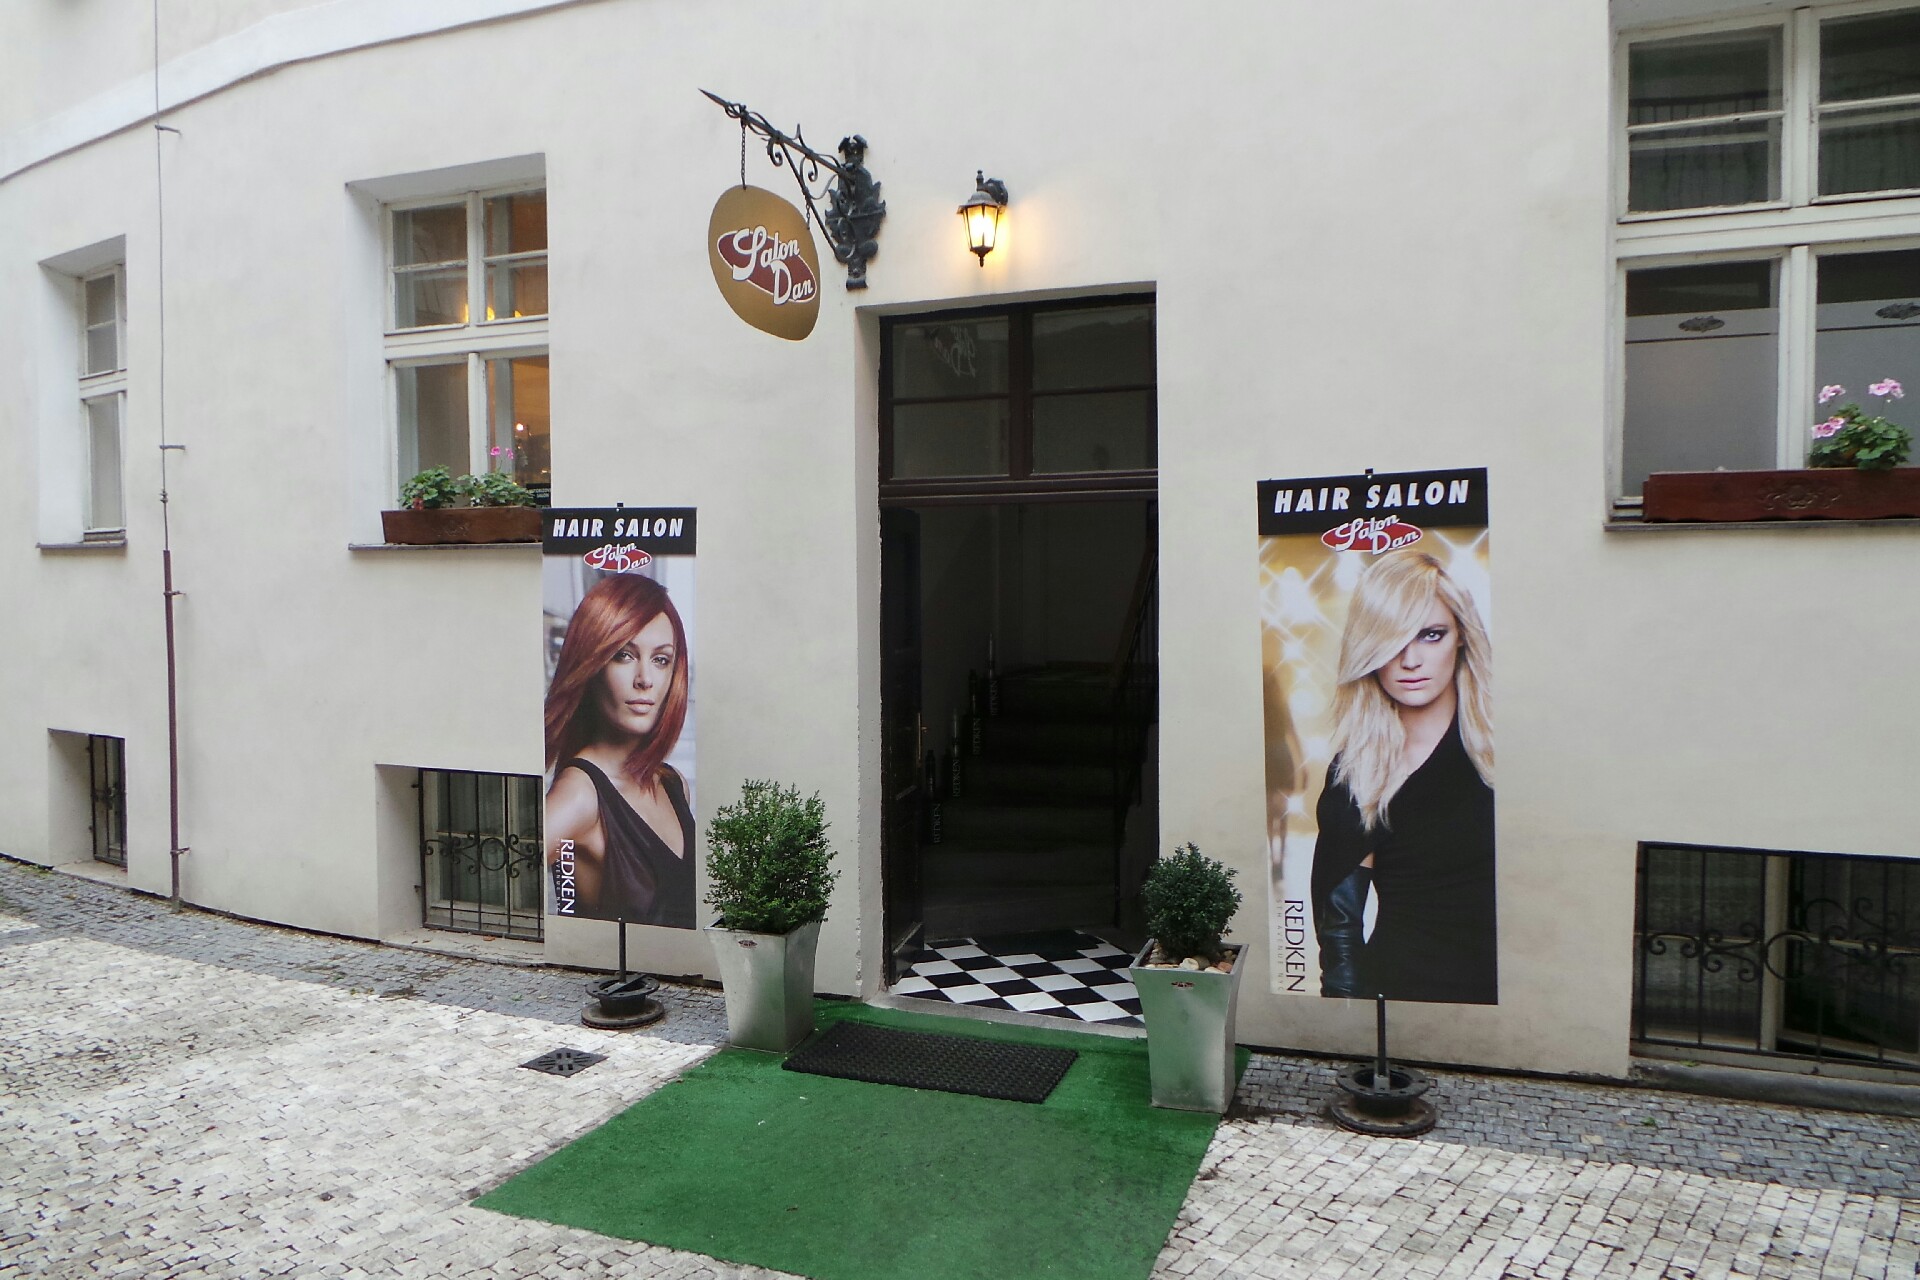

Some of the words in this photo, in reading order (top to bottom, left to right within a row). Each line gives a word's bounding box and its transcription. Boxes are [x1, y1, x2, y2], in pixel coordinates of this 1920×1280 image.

[733, 226, 800, 280] Salon
[770, 260, 813, 305] Dan
[1274, 487, 1350, 513] HAIR
[1366, 479, 1469, 508] SALON
[552, 518, 604, 537] HAIR
[613, 518, 684, 537] SALON
[1335, 514, 1400, 552] Salon
[1367, 530, 1419, 555] Dan
[592, 542, 637, 570] Salon
[615, 553, 649, 573] Dan
[952, 758, 961, 798] REDKEN
[560, 839, 575, 914] REDKEN
[1284, 900, 1306, 992] REDKEN
